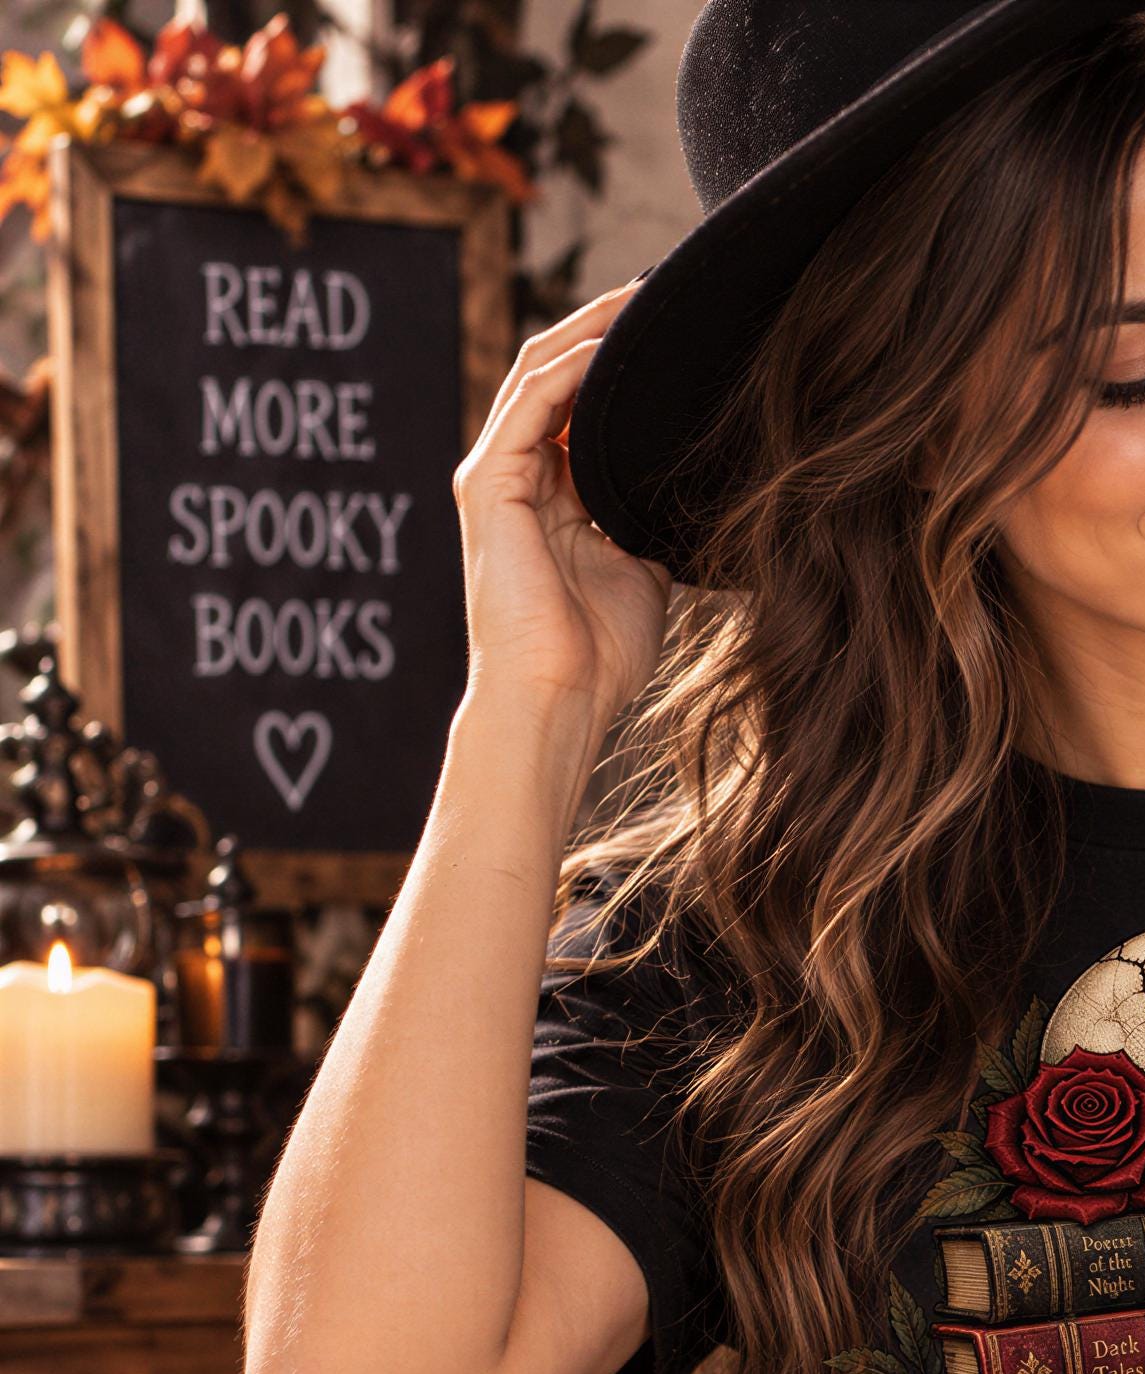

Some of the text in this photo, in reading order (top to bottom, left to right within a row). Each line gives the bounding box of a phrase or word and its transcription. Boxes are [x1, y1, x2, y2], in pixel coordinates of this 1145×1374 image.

[202, 261, 370, 351] READ
[200, 376, 375, 460] MORE
[168, 482, 411, 574] SPOOKY
[191, 593, 394, 680] BOOKS
